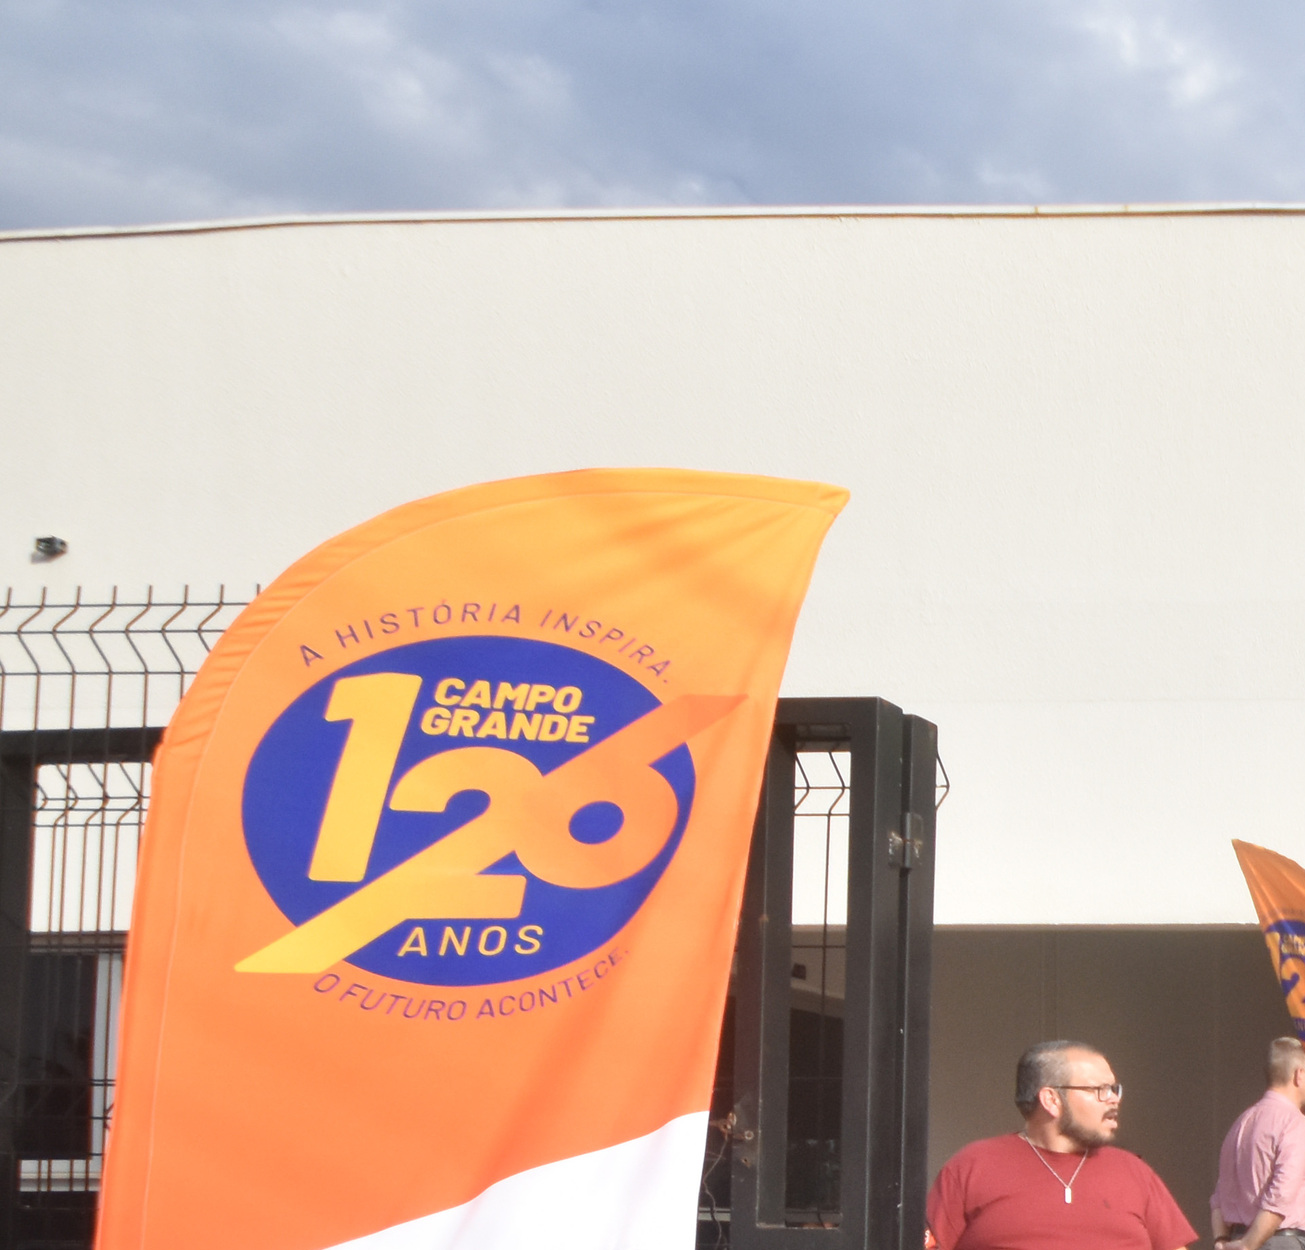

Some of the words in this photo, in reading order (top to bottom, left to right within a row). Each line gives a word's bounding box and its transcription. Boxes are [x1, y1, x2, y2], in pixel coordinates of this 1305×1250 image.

[300, 643, 324, 667] A
[335, 600, 522, 649] HISTÓRIA
[539, 608, 671, 684] INSPIRA.
[433, 677, 583, 715] CAMPO
[420, 707, 596, 744] GRANDE
[234, 671, 749, 973] 126
[398, 925, 543, 957] ANOS
[313, 973, 341, 994] O
[339, 985, 468, 1022] FUTURO
